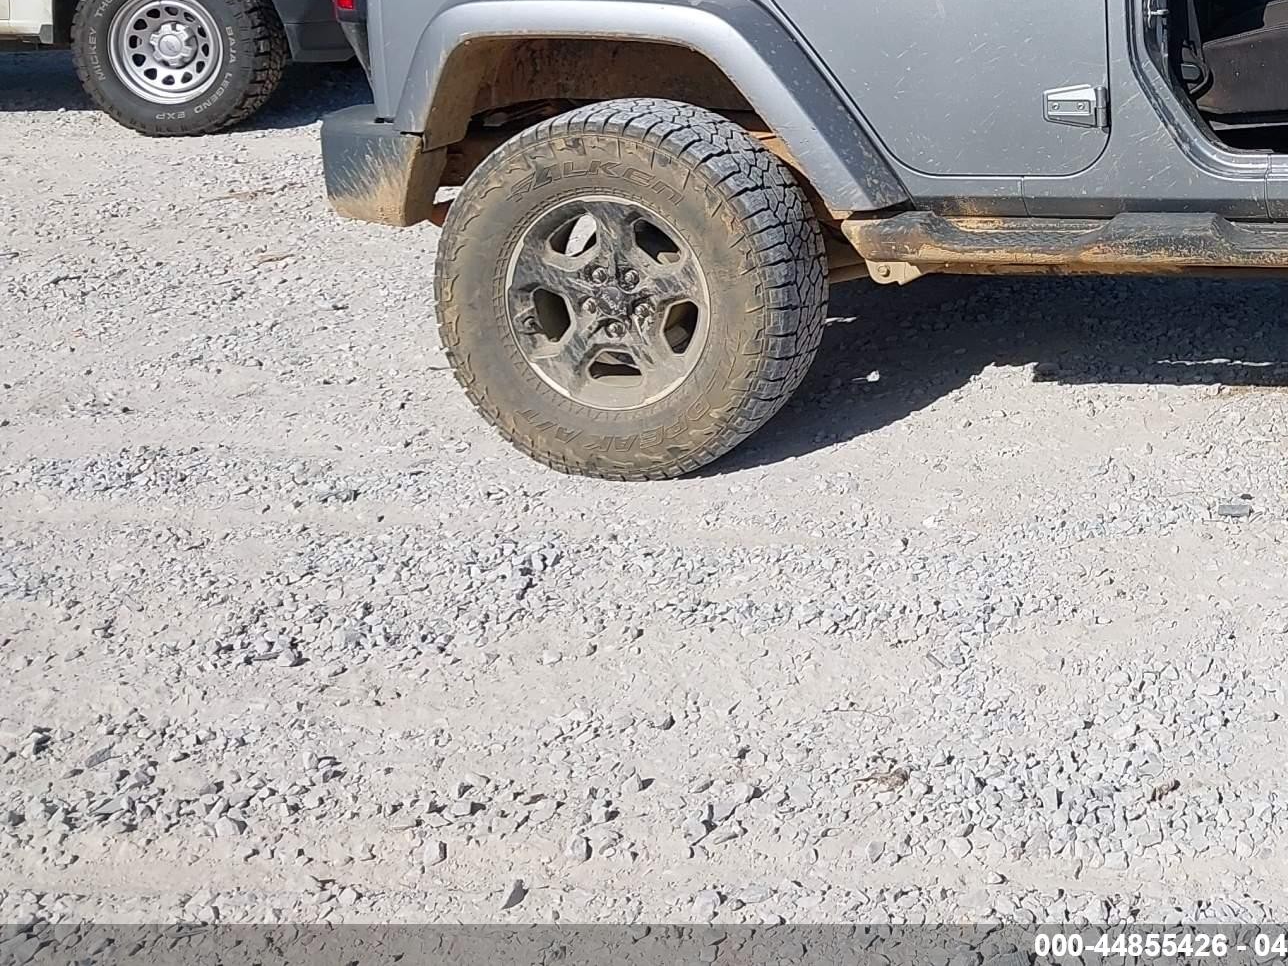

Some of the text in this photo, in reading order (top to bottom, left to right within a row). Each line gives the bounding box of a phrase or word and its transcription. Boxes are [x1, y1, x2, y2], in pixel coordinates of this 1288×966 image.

[87, 25, 106, 81] MICKEY
[155, 26, 237, 120] BAJA LEGEND EXP
